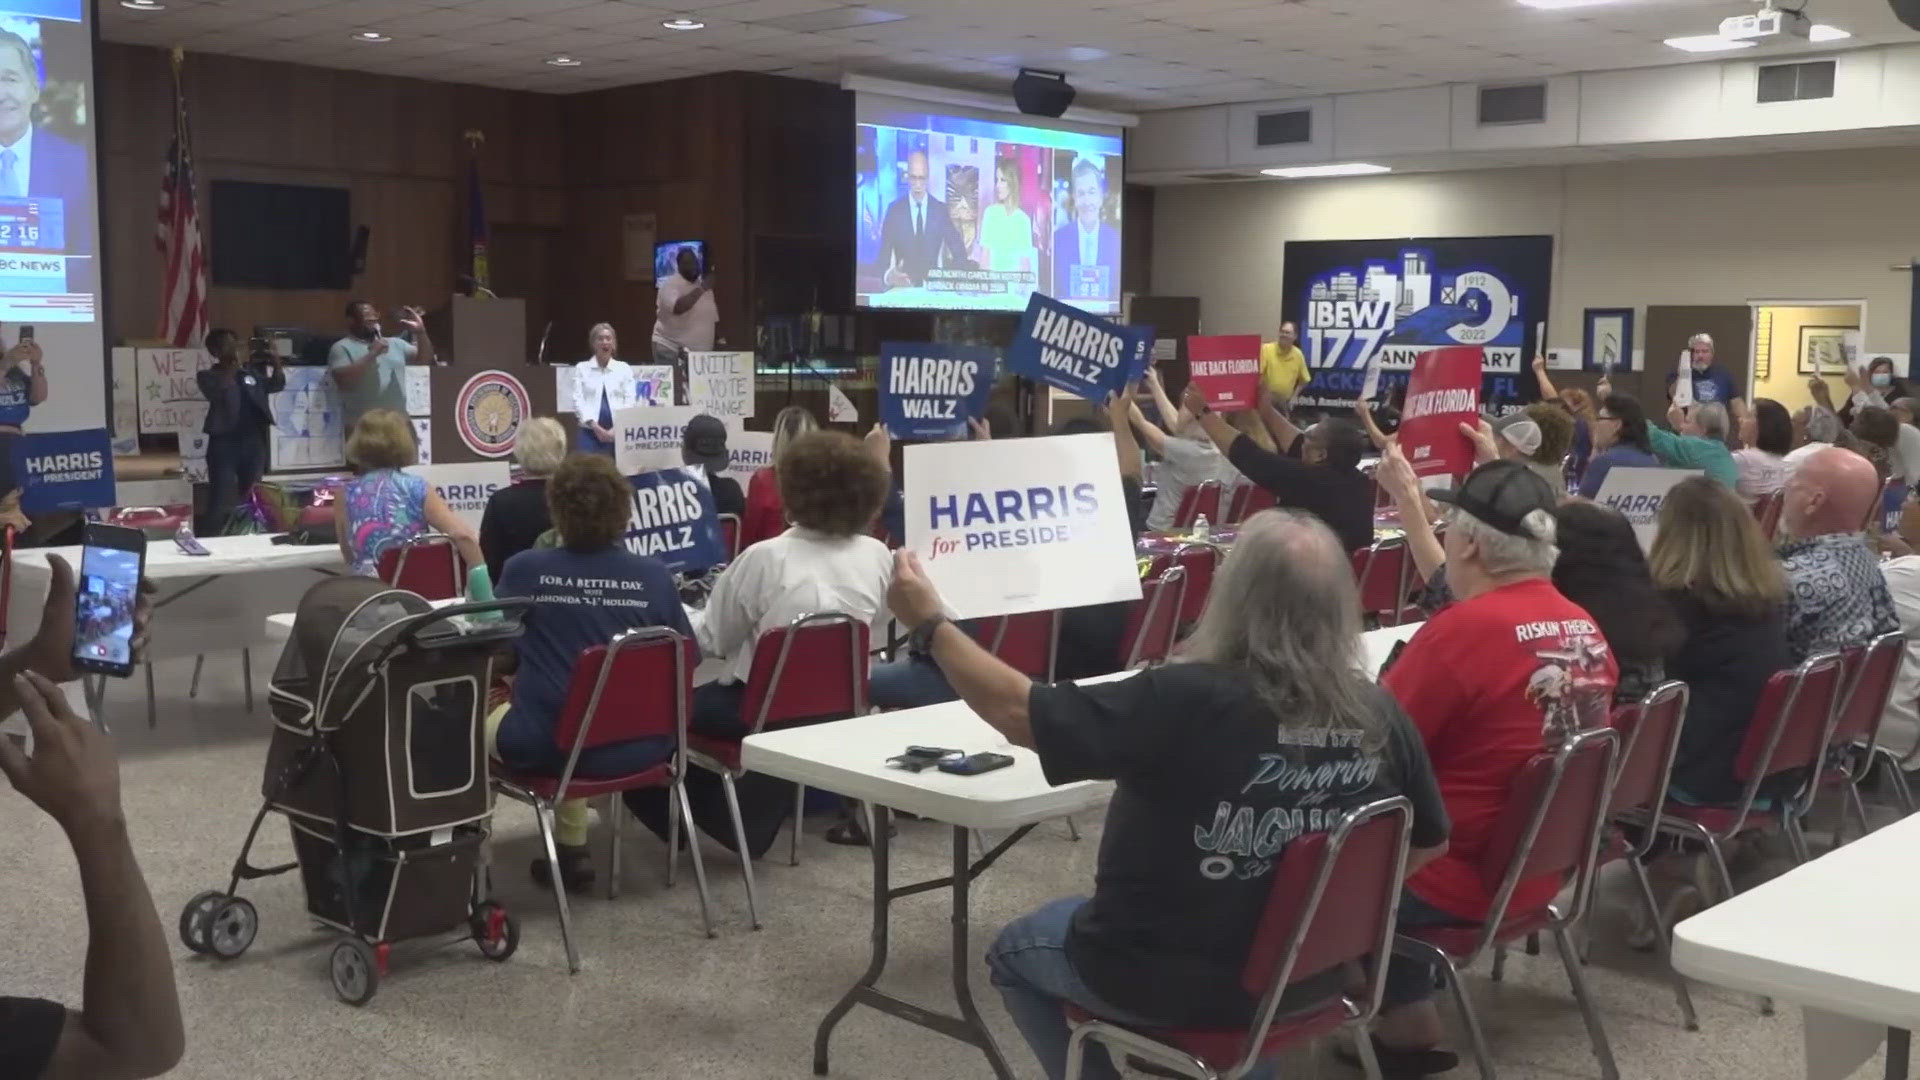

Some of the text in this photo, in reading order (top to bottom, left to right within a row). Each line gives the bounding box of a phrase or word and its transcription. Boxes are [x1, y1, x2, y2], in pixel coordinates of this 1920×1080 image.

[20, 260, 61, 272] NEWS
[1463, 275, 1486, 287] 1912
[1308, 300, 1386, 329] IBEW
[1031, 307, 1124, 369] HARRIS
[1459, 329, 1486, 340] 2022
[1307, 329, 1393, 370] 177
[1380, 350, 1516, 370] ANNARY
[152, 351, 185, 377] WE
[692, 354, 740, 376] UNITE
[1039, 346, 1102, 385] WALZ
[1191, 358, 1259, 377] TAKE BACK FLORIDA
[889, 356, 978, 397] HARRIS
[708, 378, 748, 398] VOTE
[902, 399, 956, 419] WALZ
[1432, 387, 1476, 414] FLORIDA
[142, 406, 195, 429] GOING
[26, 451, 103, 474] HARRIS
[729, 449, 773, 464] ARRI
[43, 469, 103, 483] PRESIDENT
[435, 483, 498, 502] ARRIS
[627, 480, 703, 533] ARRIS
[929, 483, 1099, 530] HARRIS
[624, 526, 695, 557] WALZ
[928, 537, 960, 560] for
[540, 575, 563, 586] FOR
[565, 578, 573, 586] A
[576, 578, 619, 589] BETTER
[1516, 621, 1560, 643] RISKIN
